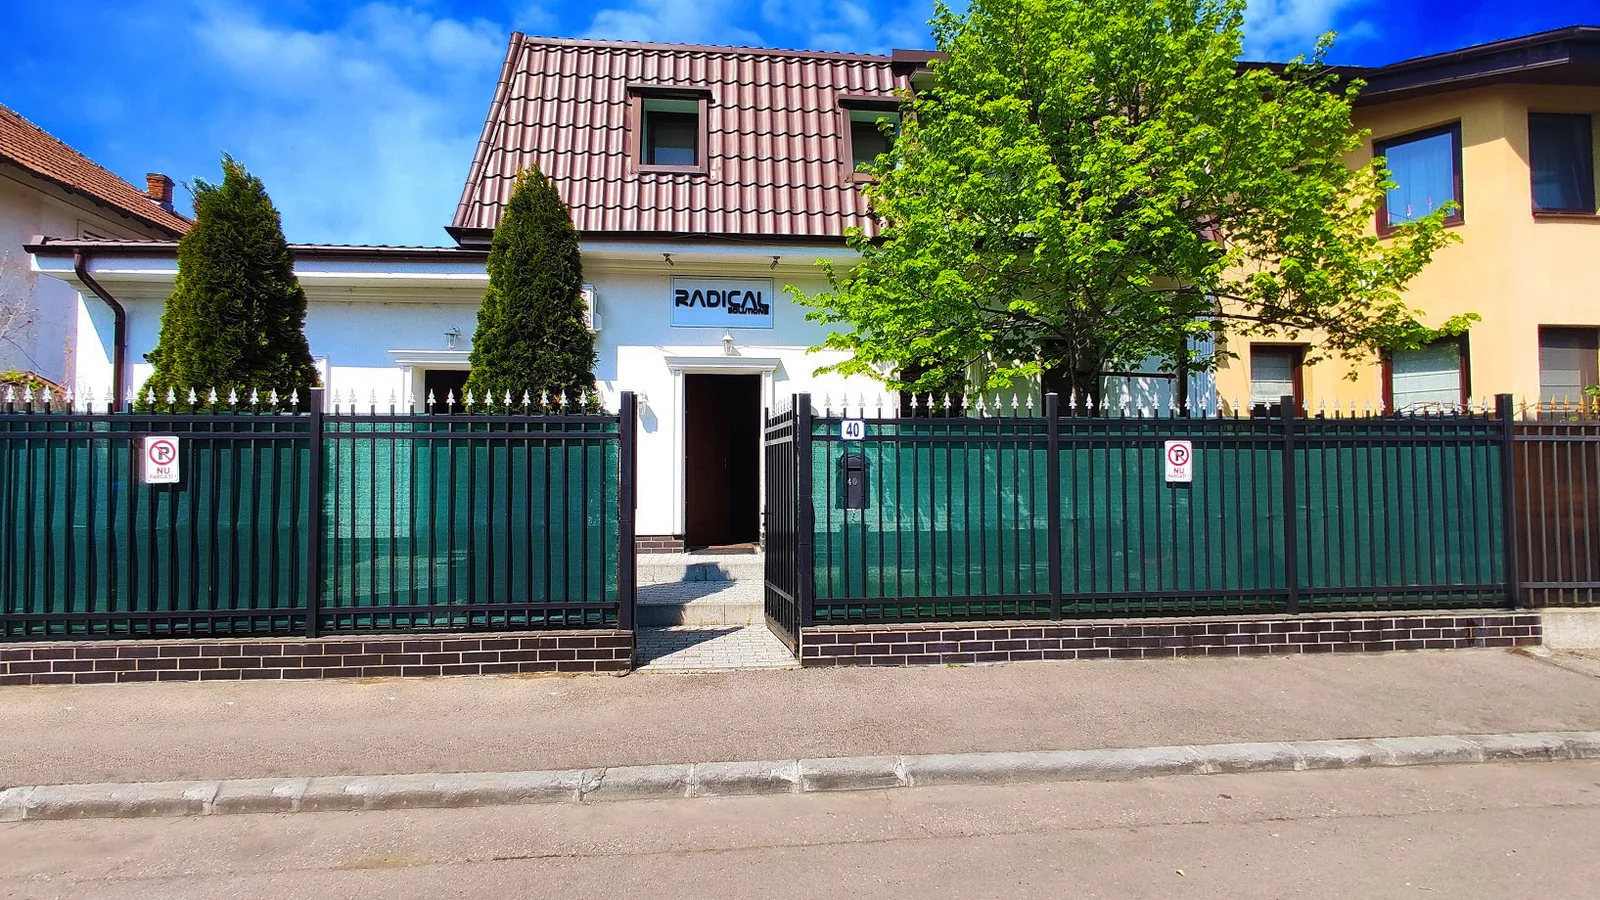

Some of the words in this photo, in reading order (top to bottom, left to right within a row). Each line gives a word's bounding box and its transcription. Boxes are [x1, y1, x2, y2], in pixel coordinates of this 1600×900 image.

[675, 289, 769, 308] RADICAL
[727, 306, 770, 315] SOLUTIONS
[846, 422, 859, 437] 40
[157, 467, 170, 475] NU
[847, 477, 858, 486] 40
